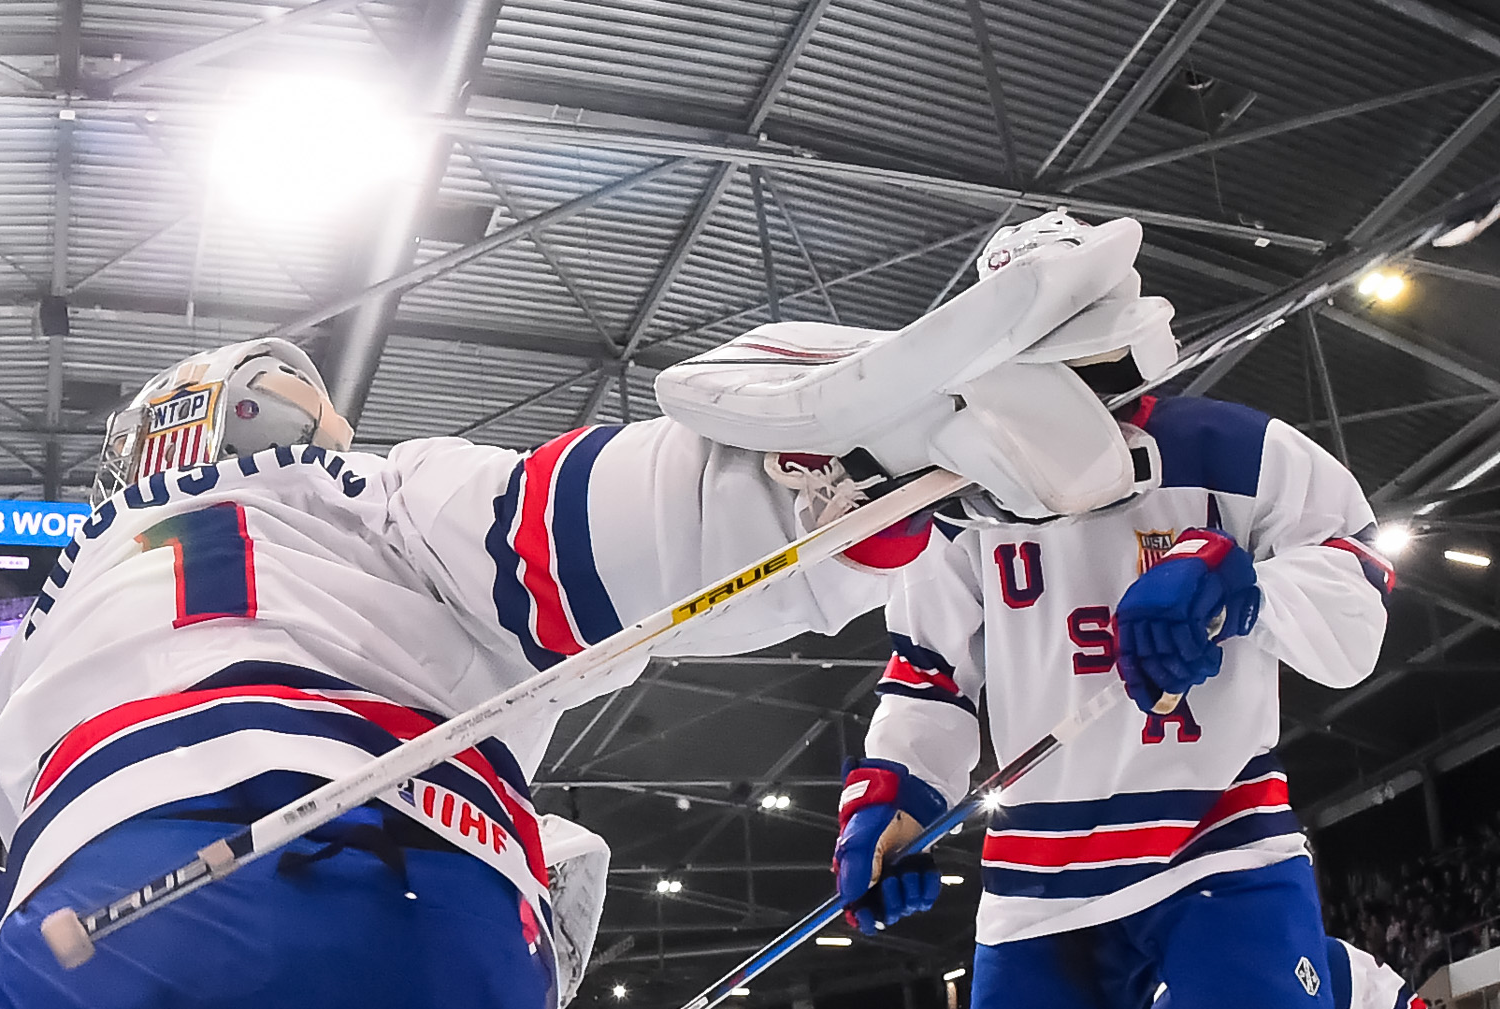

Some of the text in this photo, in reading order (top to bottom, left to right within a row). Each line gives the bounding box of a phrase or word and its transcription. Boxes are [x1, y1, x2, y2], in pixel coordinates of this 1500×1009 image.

[134, 500, 258, 630] 1
[678, 553, 788, 616] TRUE
[994, 541, 1045, 610] U
[422, 785, 508, 855] IIHF
[86, 862, 207, 933] TRUE
